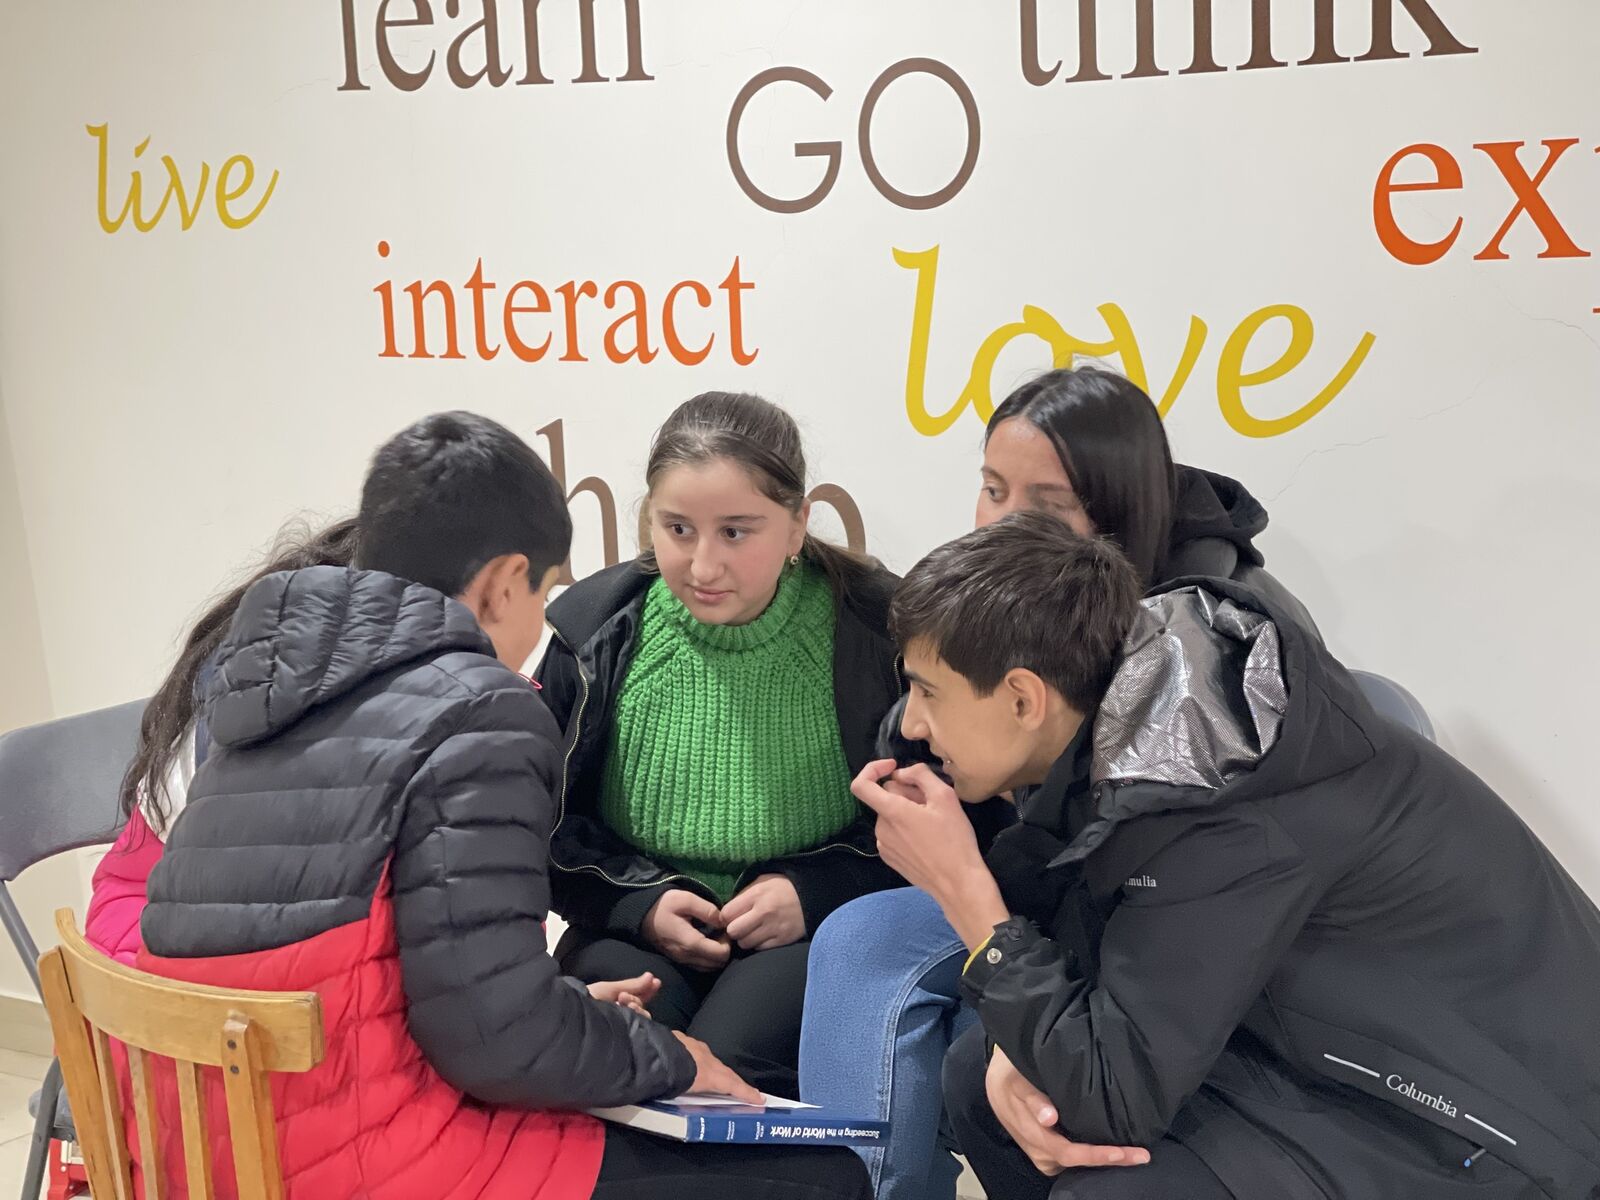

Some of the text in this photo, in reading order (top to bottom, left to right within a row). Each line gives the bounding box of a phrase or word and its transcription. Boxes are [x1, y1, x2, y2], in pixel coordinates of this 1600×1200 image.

[337, 0, 654, 91] learn
[86, 123, 279, 234] live
[727, 58, 980, 213] GO
[1373, 138, 1600, 266] ex
[374, 241, 759, 366] interact
[892, 244, 1377, 438] love
[770, 1125, 880, 1139] Succeeding in the World of Work
[1386, 1074, 1457, 1118] Columbia
